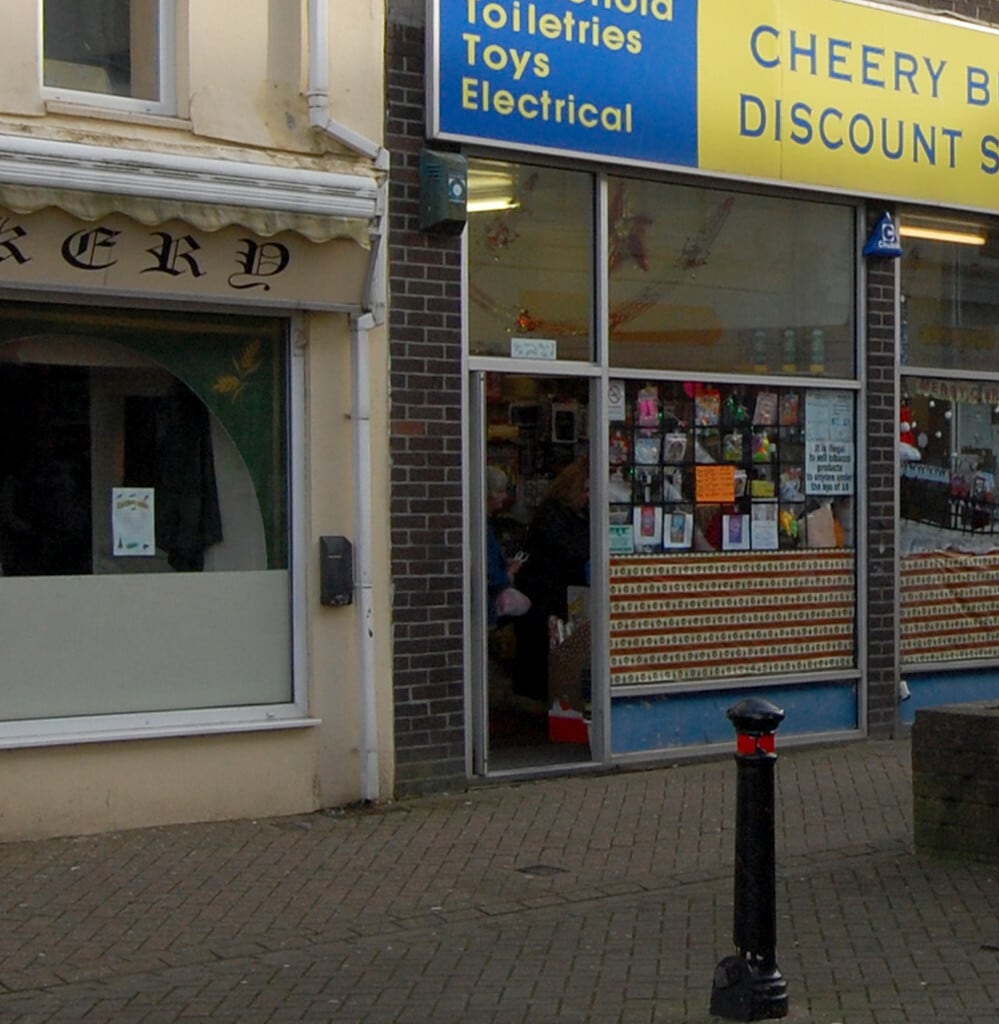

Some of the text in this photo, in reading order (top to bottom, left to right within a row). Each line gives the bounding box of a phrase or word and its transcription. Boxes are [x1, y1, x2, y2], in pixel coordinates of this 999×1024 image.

[463, 33, 551, 80] Toys
[750, 24, 947, 98] CHEERY
[462, 78, 633, 133] Electrical
[739, 93, 962, 168] DISCOUNT
